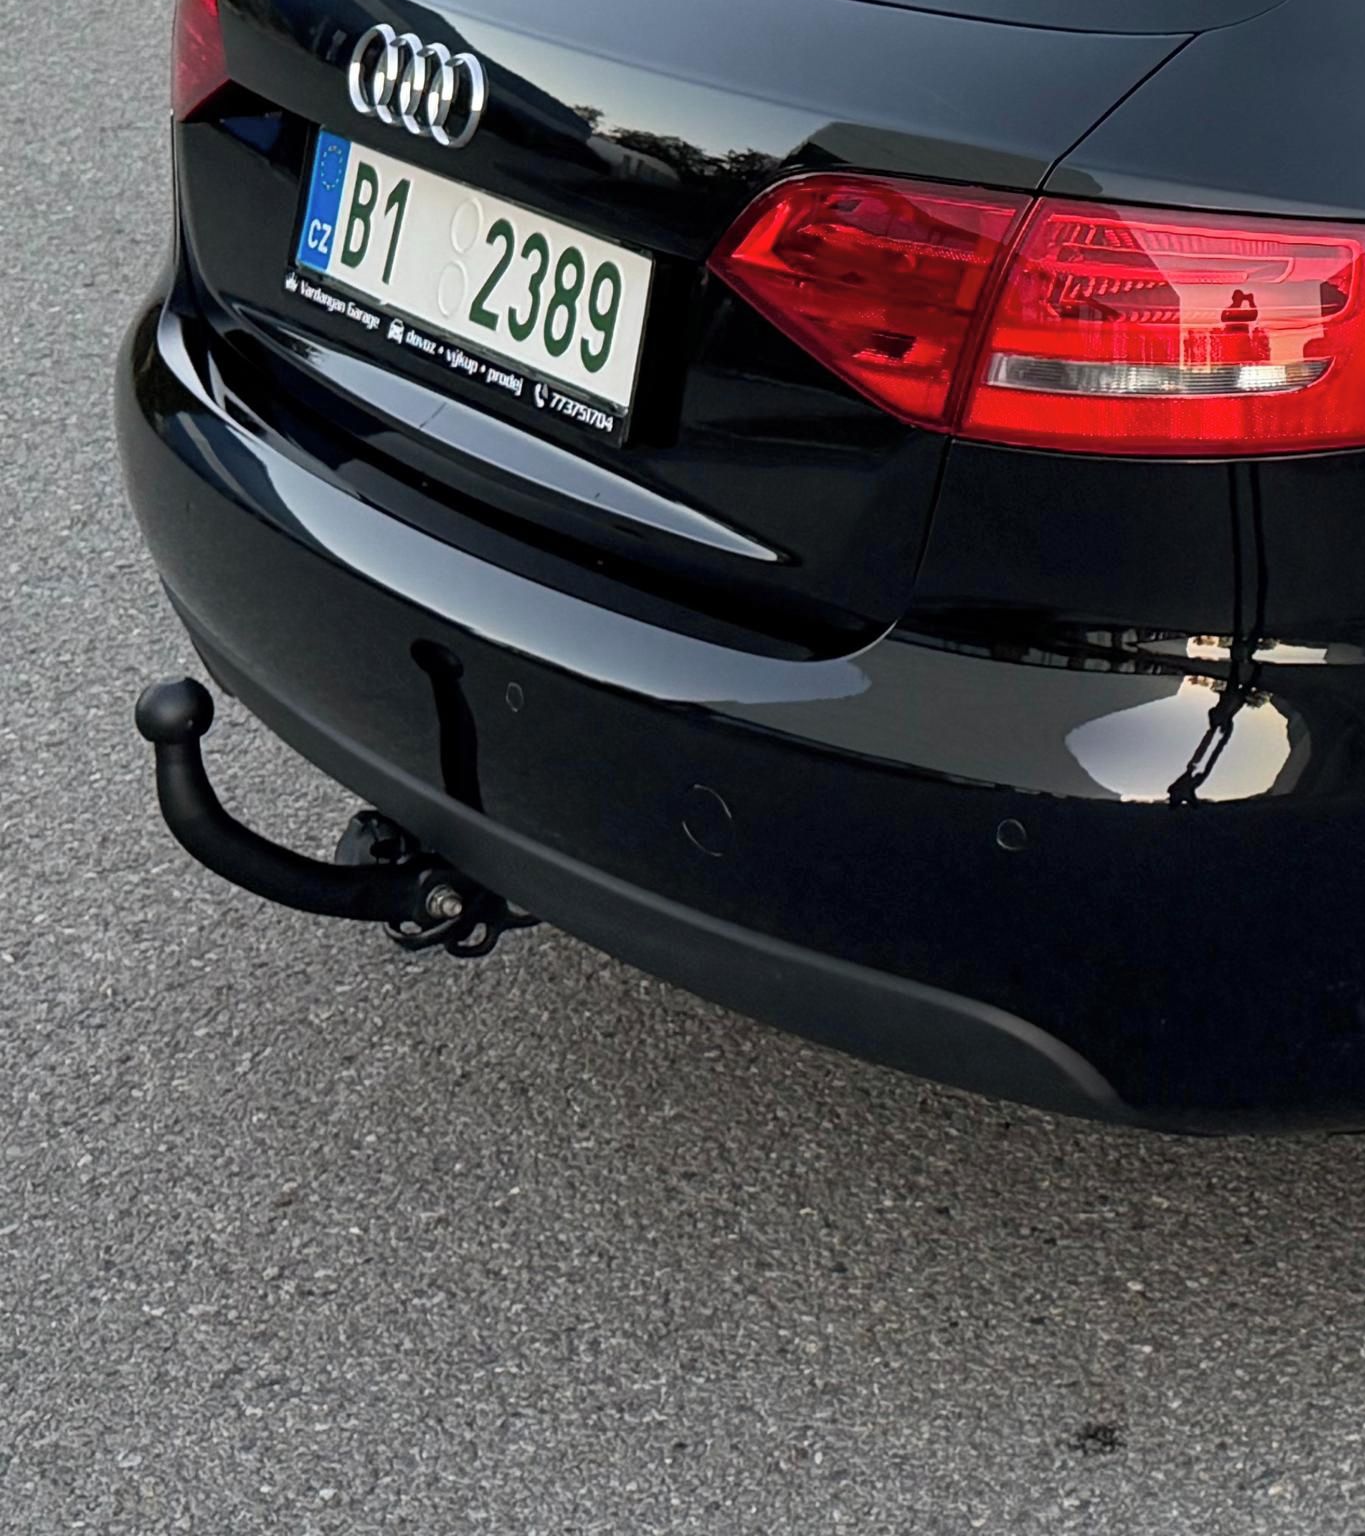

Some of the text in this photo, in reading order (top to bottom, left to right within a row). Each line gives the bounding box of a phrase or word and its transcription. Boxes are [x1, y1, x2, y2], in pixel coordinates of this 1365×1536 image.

[307, 219, 332, 255] CZ
[340, 161, 622, 374] B1 2389
[346, 301, 381, 330] Garage
[405, 329, 437, 355] dovoz
[485, 367, 523, 397] prodej
[549, 392, 614, 432] 773751704
